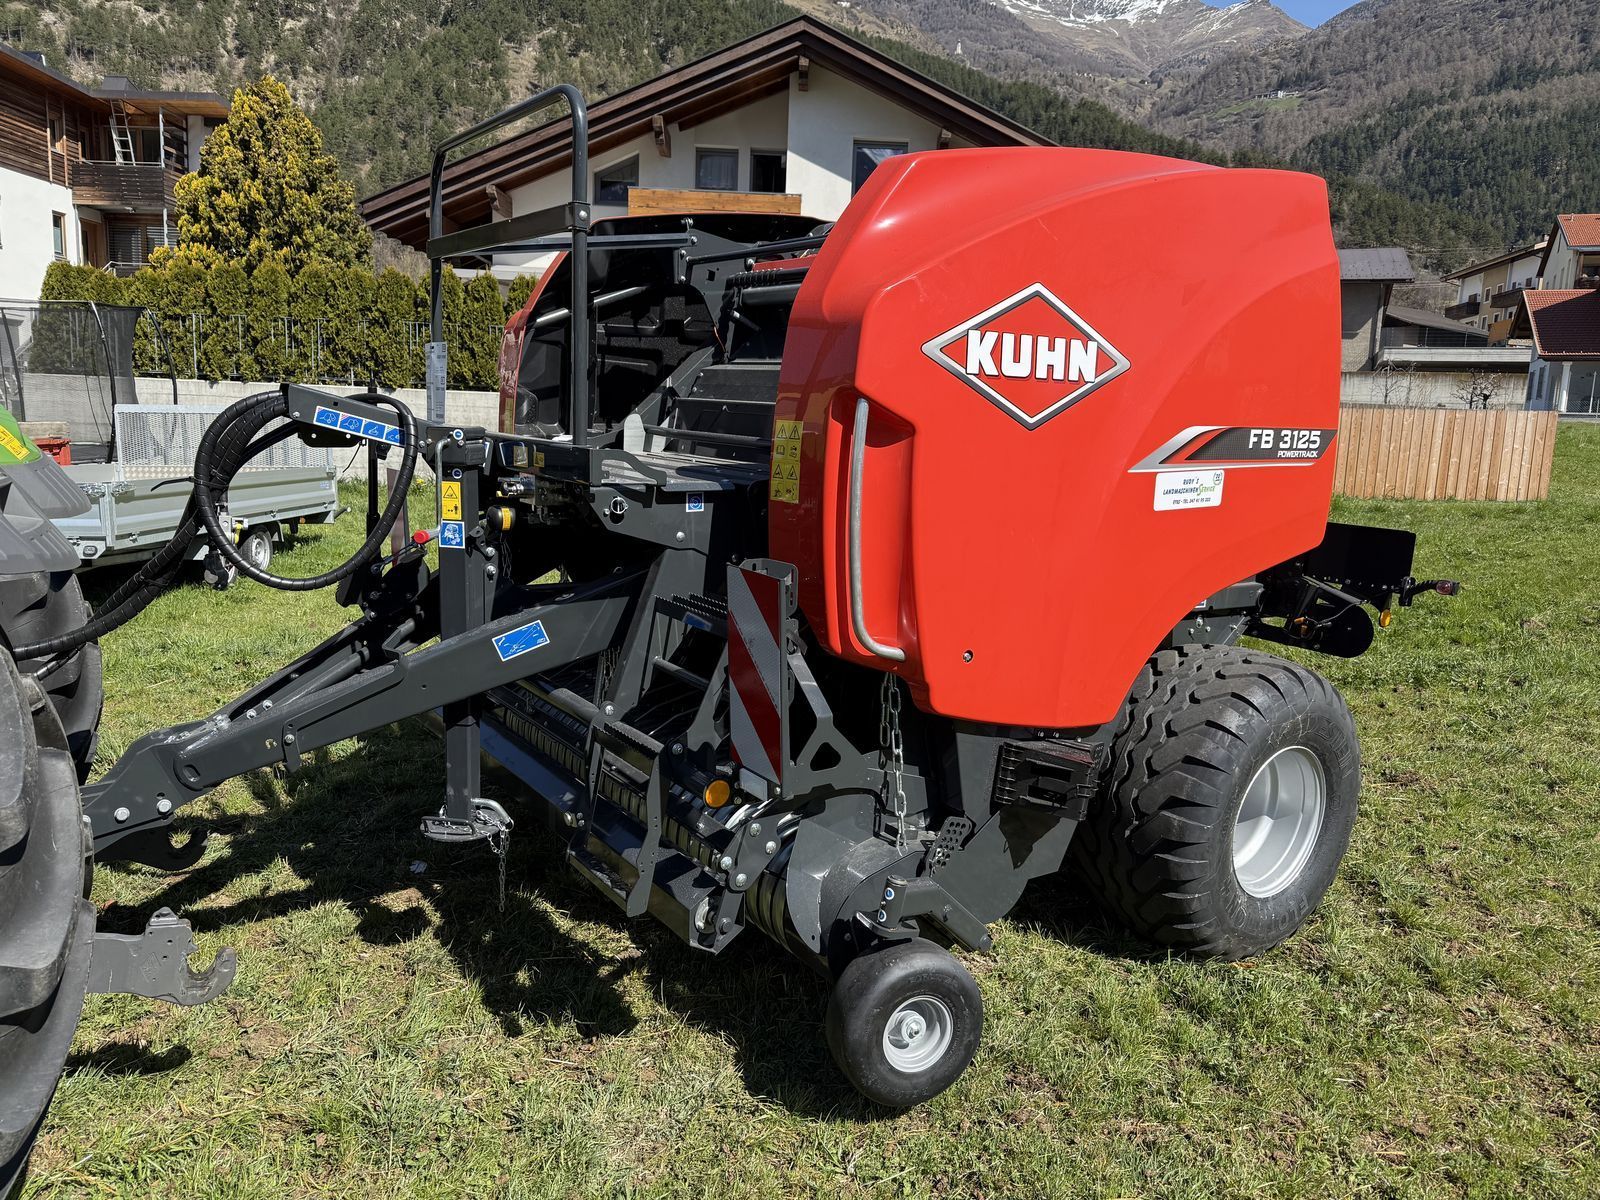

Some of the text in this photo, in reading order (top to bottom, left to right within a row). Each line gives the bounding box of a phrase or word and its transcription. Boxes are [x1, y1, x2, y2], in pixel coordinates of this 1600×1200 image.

[966, 329, 1098, 383] KUHN
[1249, 429, 1321, 449] FB 3125
[1277, 450, 1318, 458] POWERTRACK
